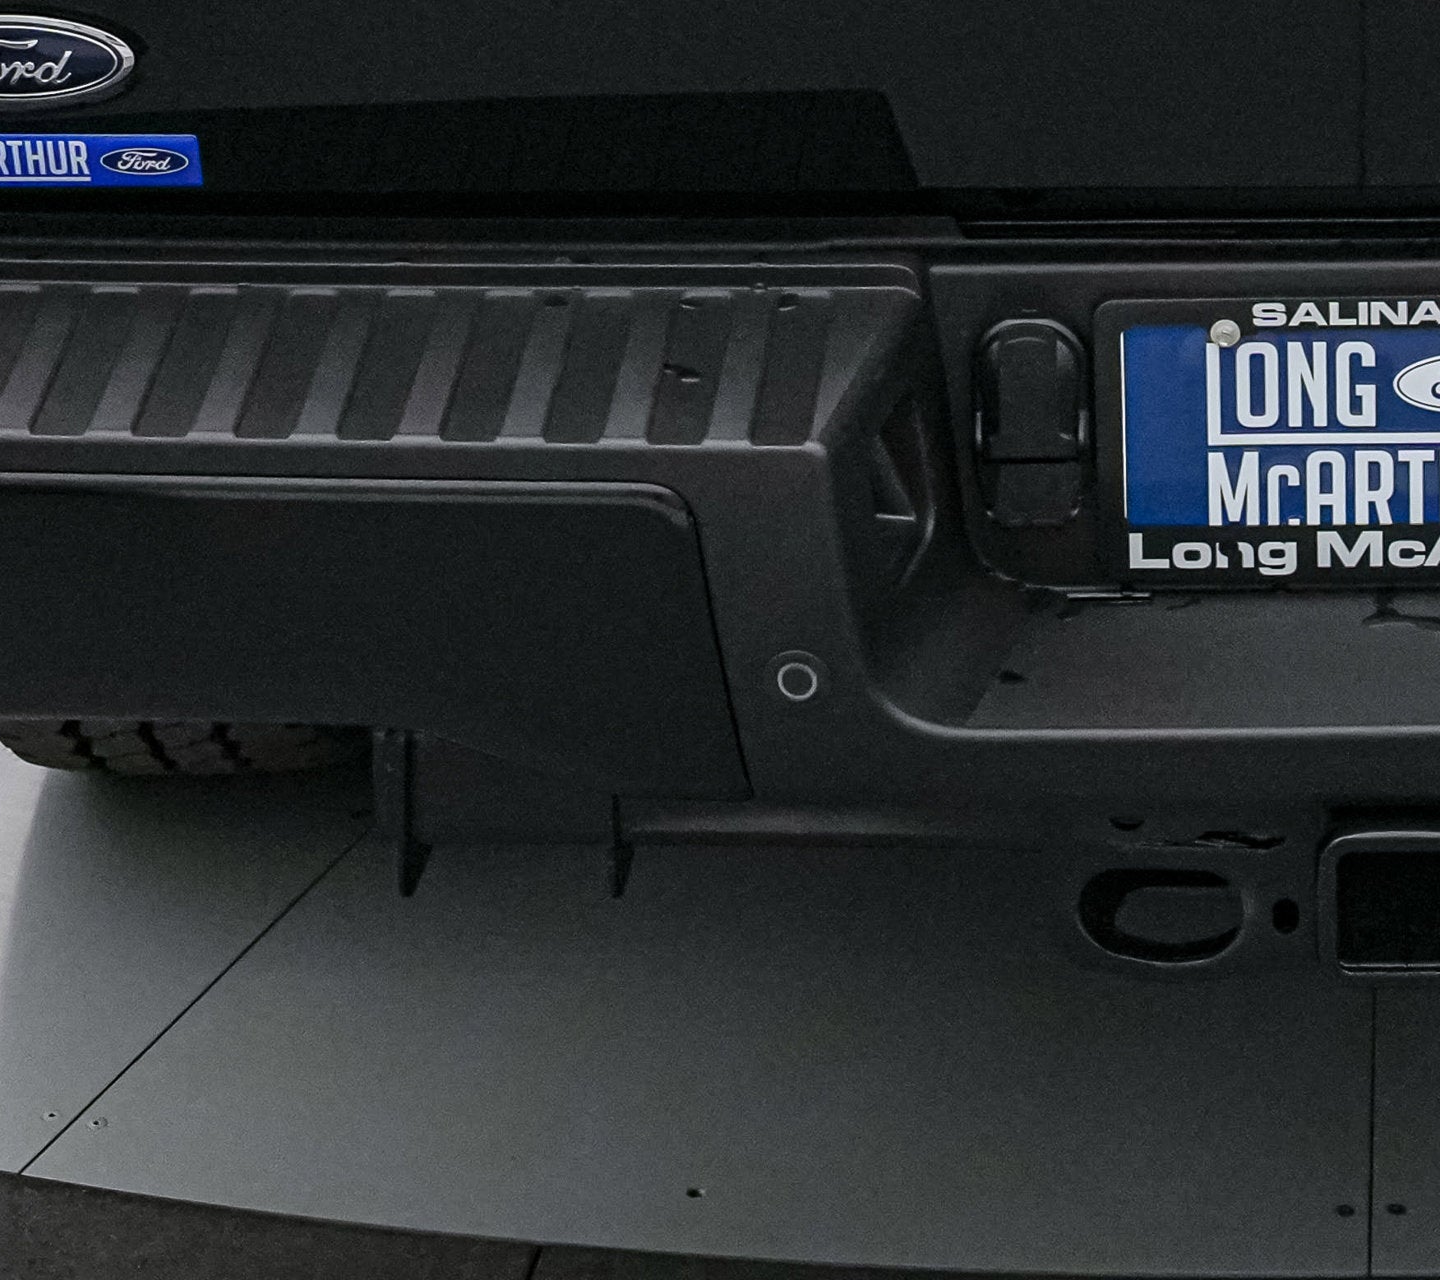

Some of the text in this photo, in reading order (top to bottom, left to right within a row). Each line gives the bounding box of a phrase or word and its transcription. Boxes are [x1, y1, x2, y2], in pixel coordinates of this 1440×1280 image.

[116, 151, 172, 173] Ford
[1206, 340, 1377, 445] LONG
[1129, 532, 1298, 576] Long
